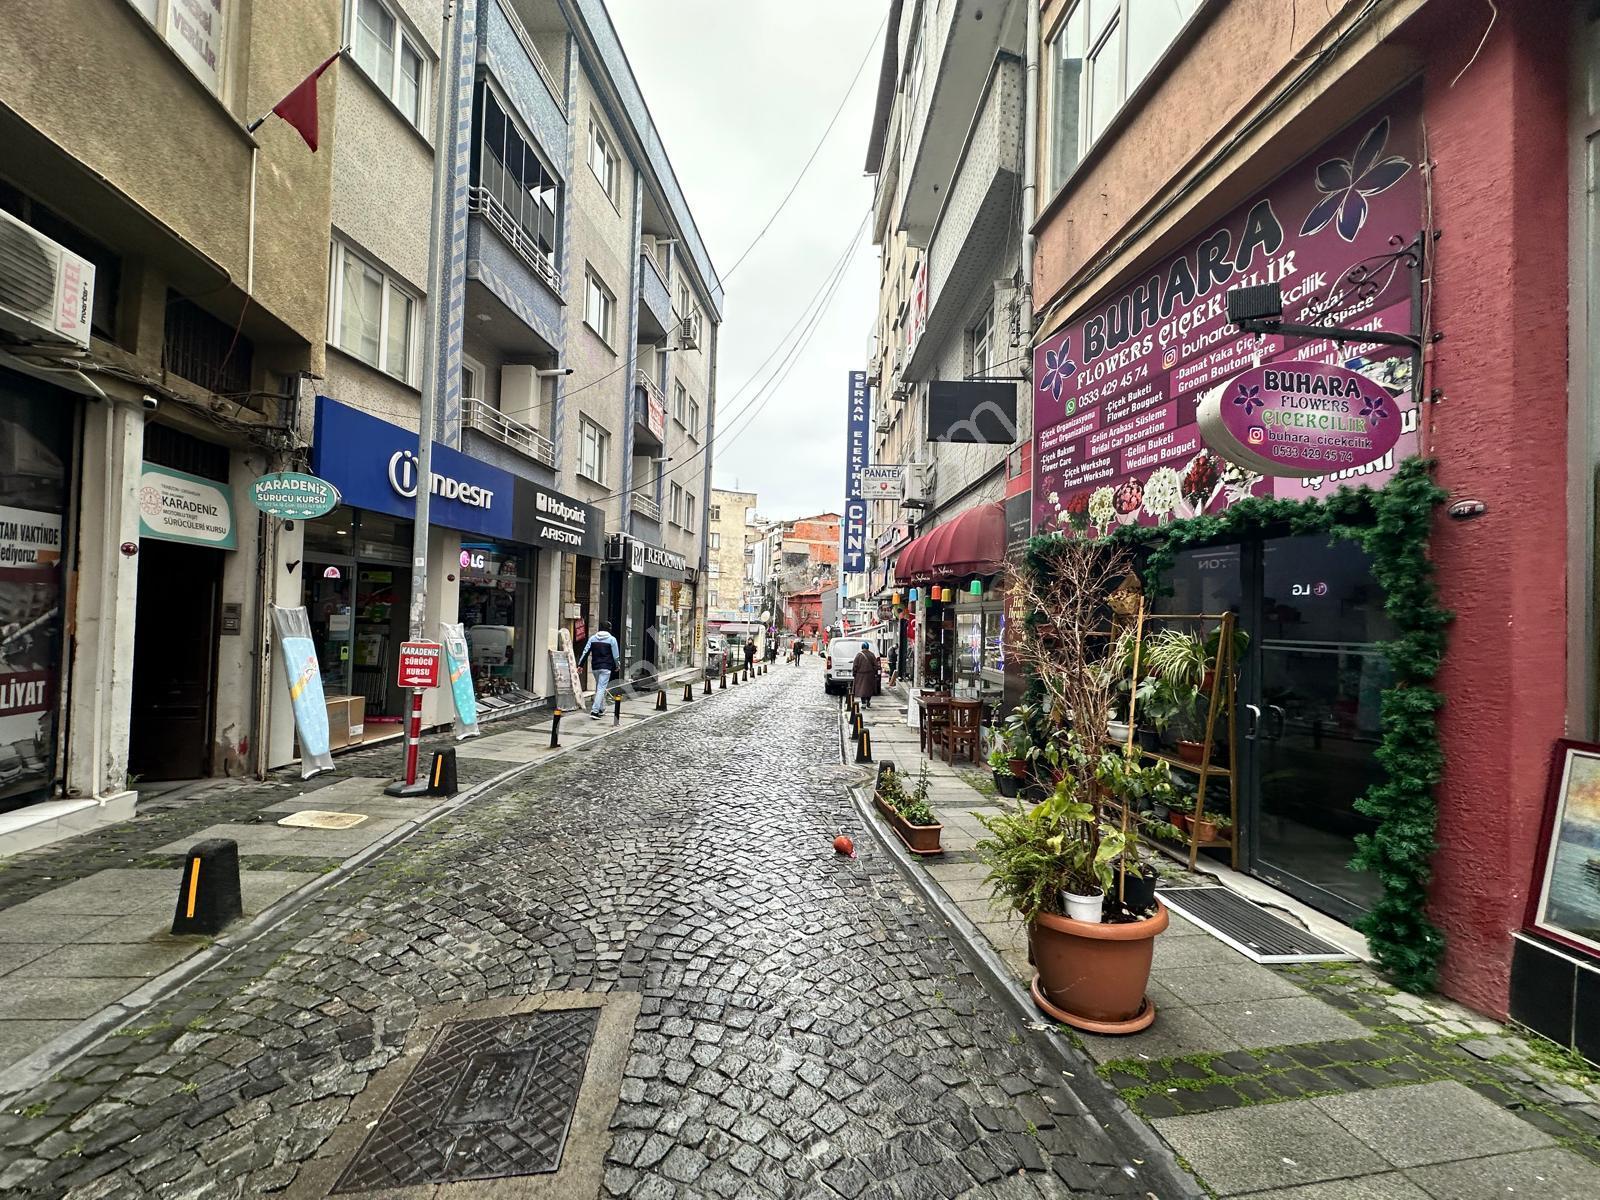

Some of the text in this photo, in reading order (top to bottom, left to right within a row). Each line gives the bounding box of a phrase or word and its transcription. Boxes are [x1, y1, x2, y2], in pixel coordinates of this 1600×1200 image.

[1082, 199, 1283, 364] BUHARA
[61, 262, 81, 328] VESTEL
[1076, 334, 1154, 390] FLOWERS
[1175, 359, 1208, 380] -Damat
[1209, 348, 1233, 366] Yaka
[1078, 364, 1149, 408] 0533 429 45 74
[1127, 383, 1153, 400] Buketi
[1178, 373, 1209, 393] Groom
[1263, 369, 1362, 399] BUHARA
[853, 373, 865, 422] SERKAN
[1280, 395, 1350, 413] FLOWERS
[1106, 406, 1130, 423] Flower
[1109, 420, 1135, 437] Arabası
[1135, 408, 1168, 428] Süsleme
[1041, 422, 1094, 450] Flower Organization
[1091, 421, 1166, 456] Bridal Car Decoration
[1148, 432, 1175, 450] Buketi
[1268, 429, 1372, 449] buhara_cicekcilik
[851, 430, 863, 497] ELEKTRİK
[1126, 452, 1159, 471] Wedding
[1272, 446, 1354, 462] 0533 429 45 74
[1041, 456, 1072, 474] Flower Care
[1080, 456, 1111, 474] Workshop
[1064, 466, 1115, 489] Flower Workshop
[255, 479, 328, 497] KARADENİZ
[257, 492, 326, 504] SÜRÜCÜ KURSU
[161, 495, 219, 517] KARADENİZ
[547, 496, 586, 525] Hotpoint
[0, 521, 59, 545] TAM VAKTİNDE
[163, 516, 227, 535] SÜRÜCÜLERİ KURSU
[540, 526, 581, 546] ARISTON
[470, 553, 485, 569] LG
[401, 646, 439, 657] KARADENİZ
[405, 656, 433, 666] SÜRÜCÜ
[406, 666, 430, 676] KURSU
